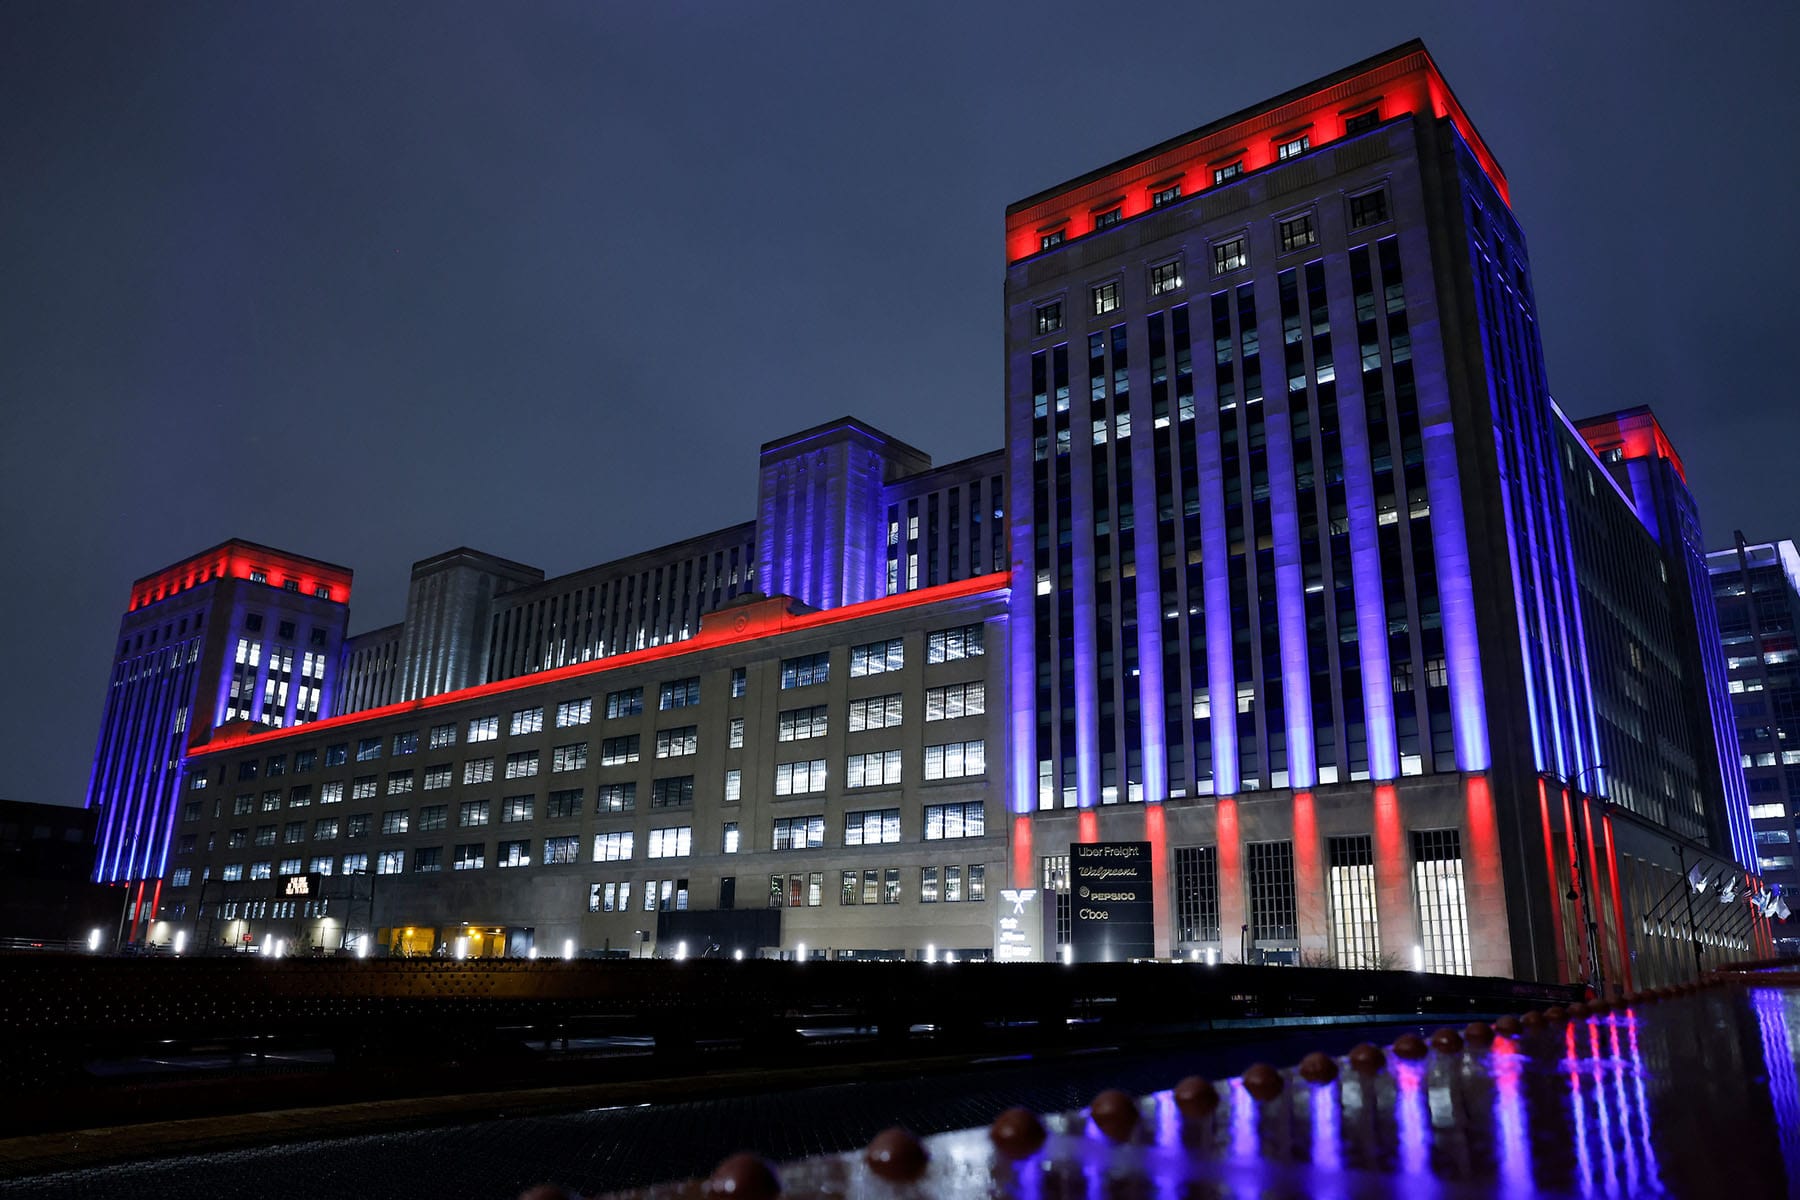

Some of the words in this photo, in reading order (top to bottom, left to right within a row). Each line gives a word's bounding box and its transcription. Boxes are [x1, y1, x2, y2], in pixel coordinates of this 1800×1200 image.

[1078, 847, 1103, 857] Uber
[1104, 846, 1140, 858] Freight
[1078, 866, 1138, 880] Walgreens
[1091, 892, 1136, 901] PEPSICO
